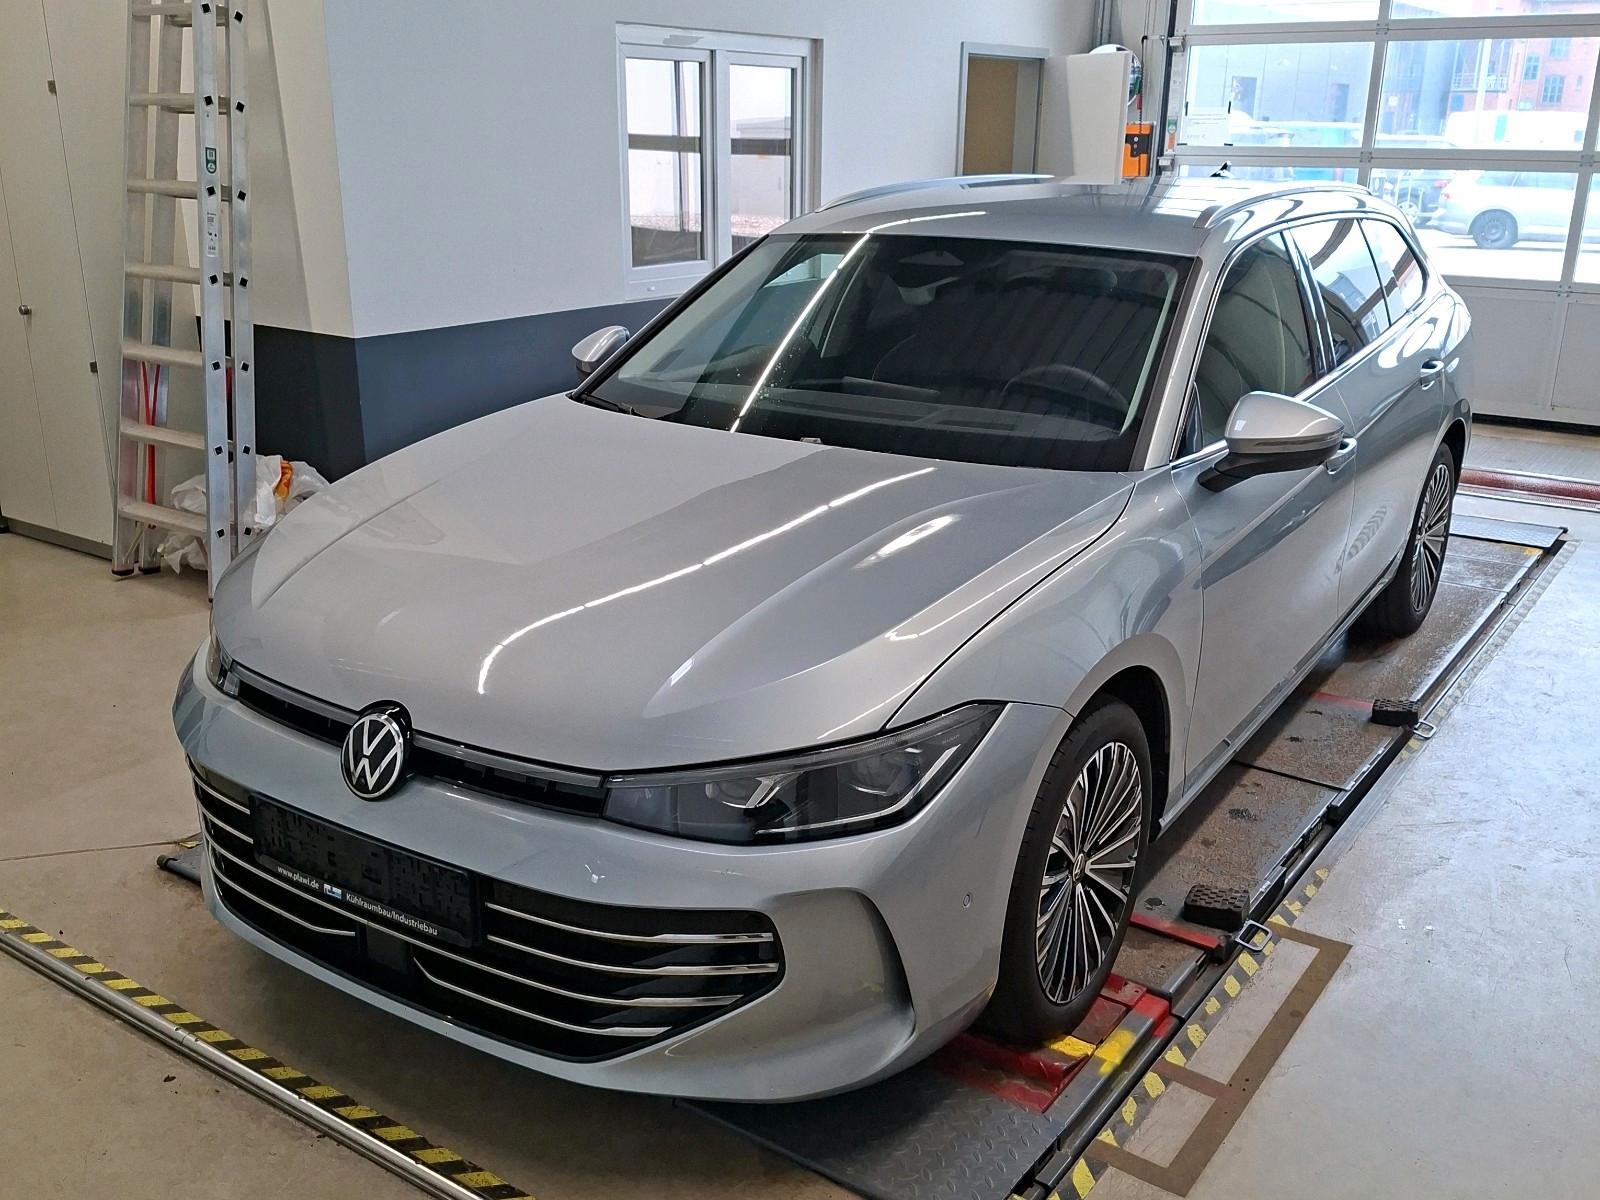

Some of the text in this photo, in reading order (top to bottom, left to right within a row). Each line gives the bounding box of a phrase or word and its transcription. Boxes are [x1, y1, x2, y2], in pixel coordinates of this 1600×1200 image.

[345, 717, 402, 794] VW
[277, 866, 438, 936] www.plawi.de Kühlraumbau/Industriebau
